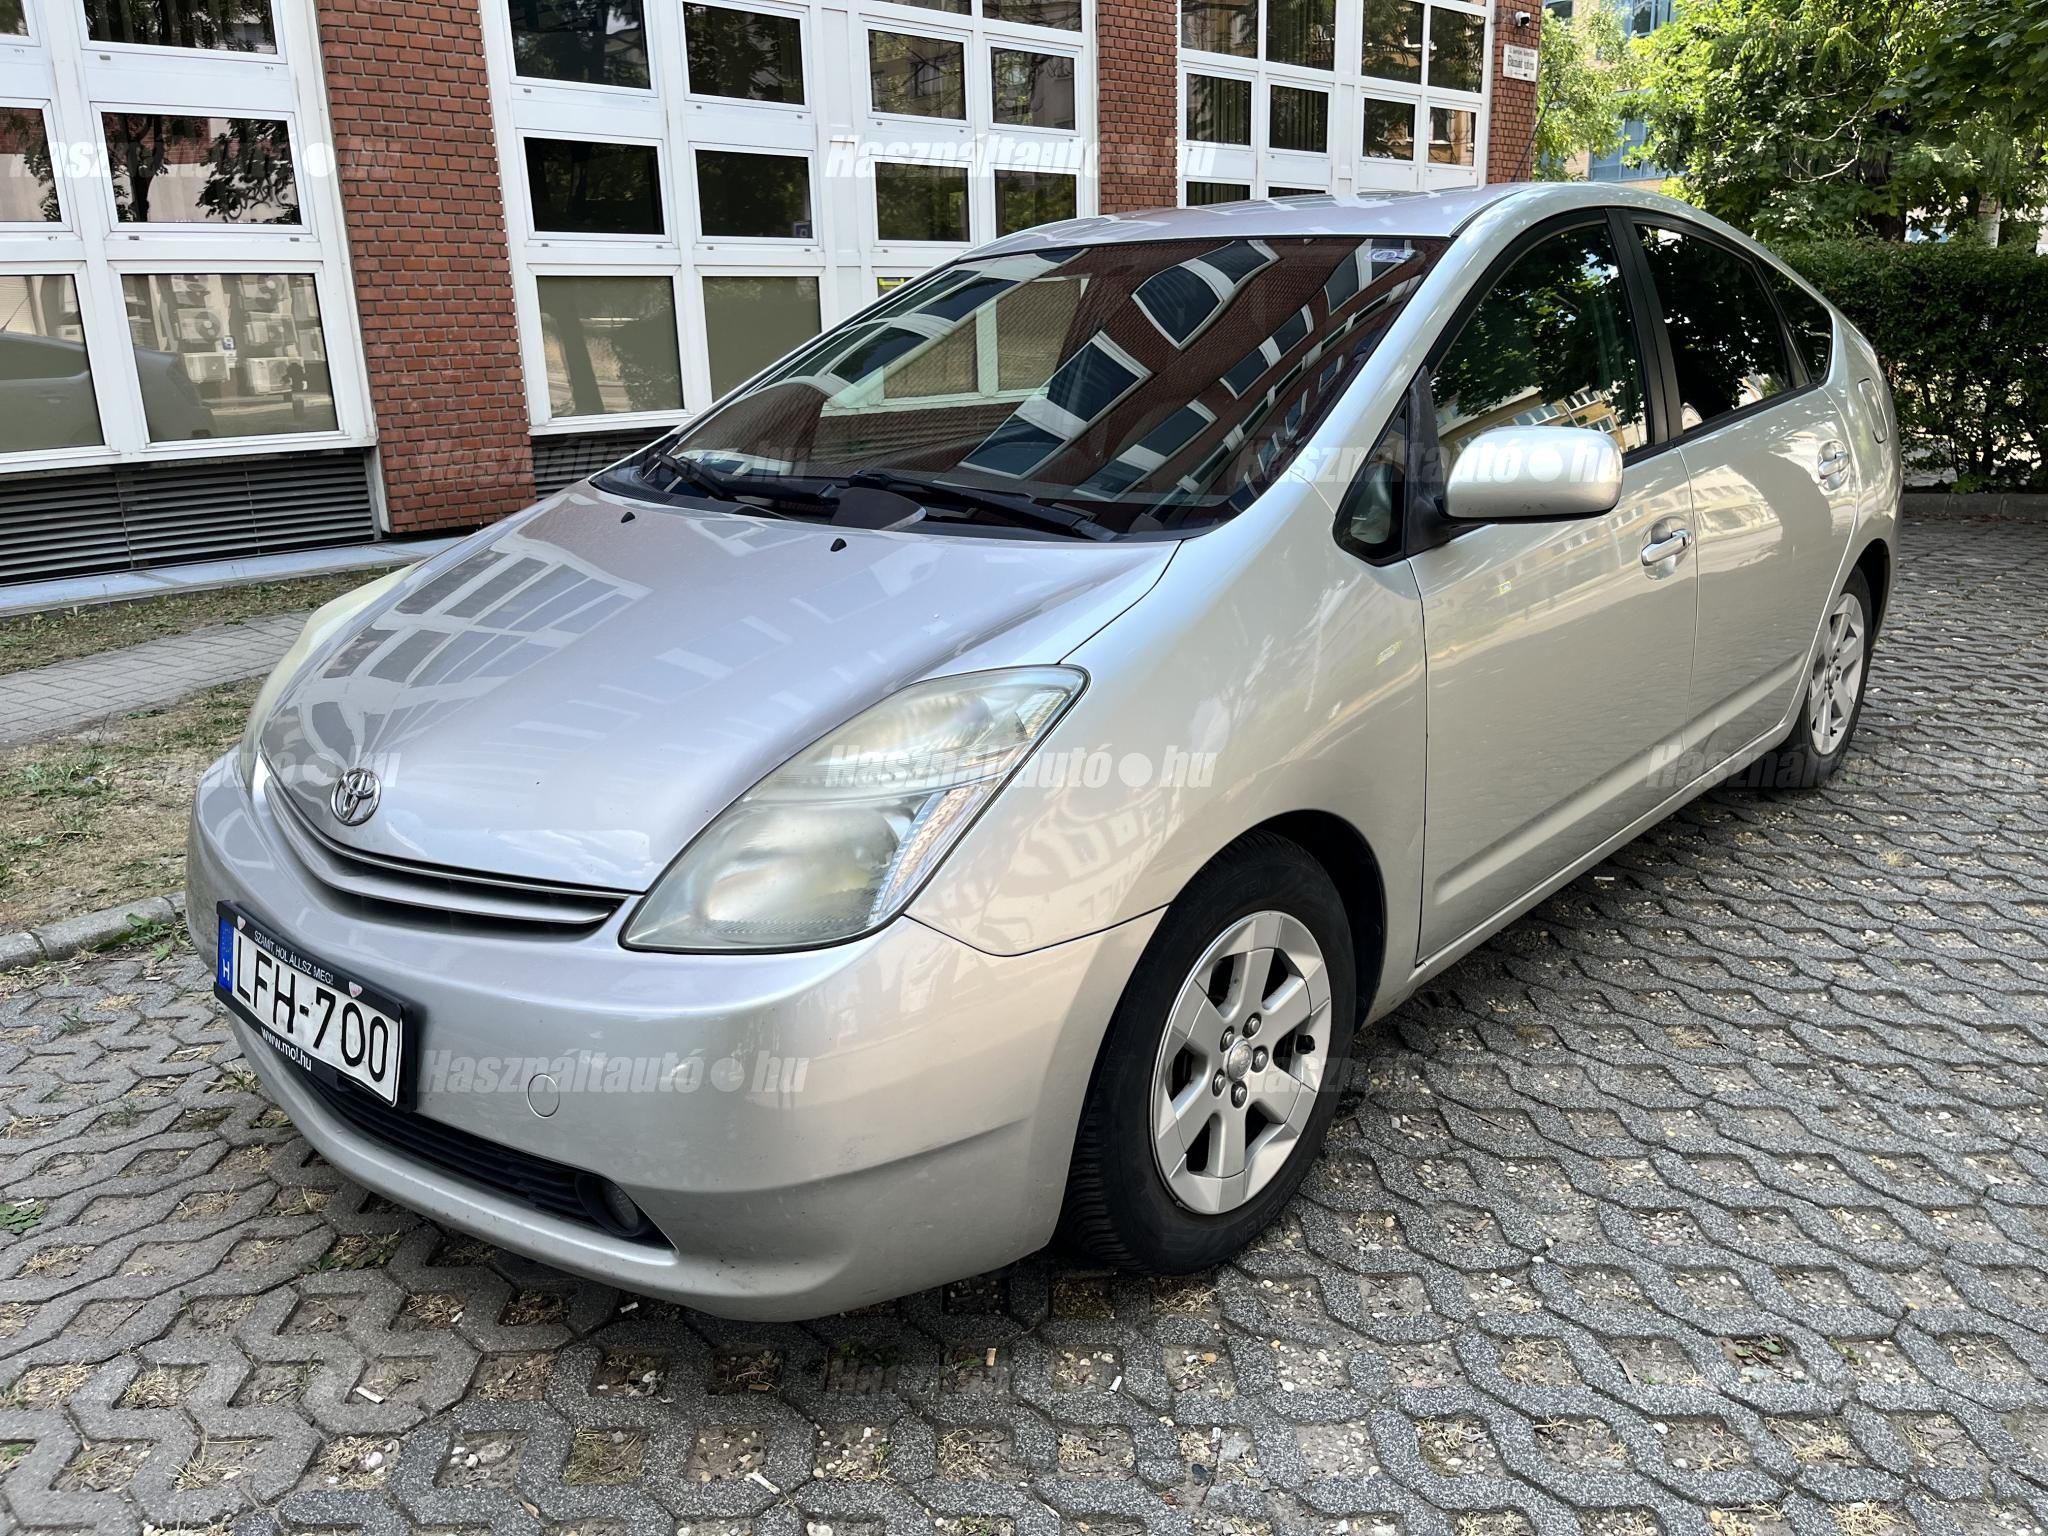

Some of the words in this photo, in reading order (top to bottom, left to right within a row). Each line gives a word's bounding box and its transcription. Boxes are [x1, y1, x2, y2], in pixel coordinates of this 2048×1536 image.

[222, 958, 230, 982] H
[275, 944, 289, 963] HOL
[237, 935, 389, 1082] LFH-700
[261, 1026, 312, 1072] www.mol.hu
